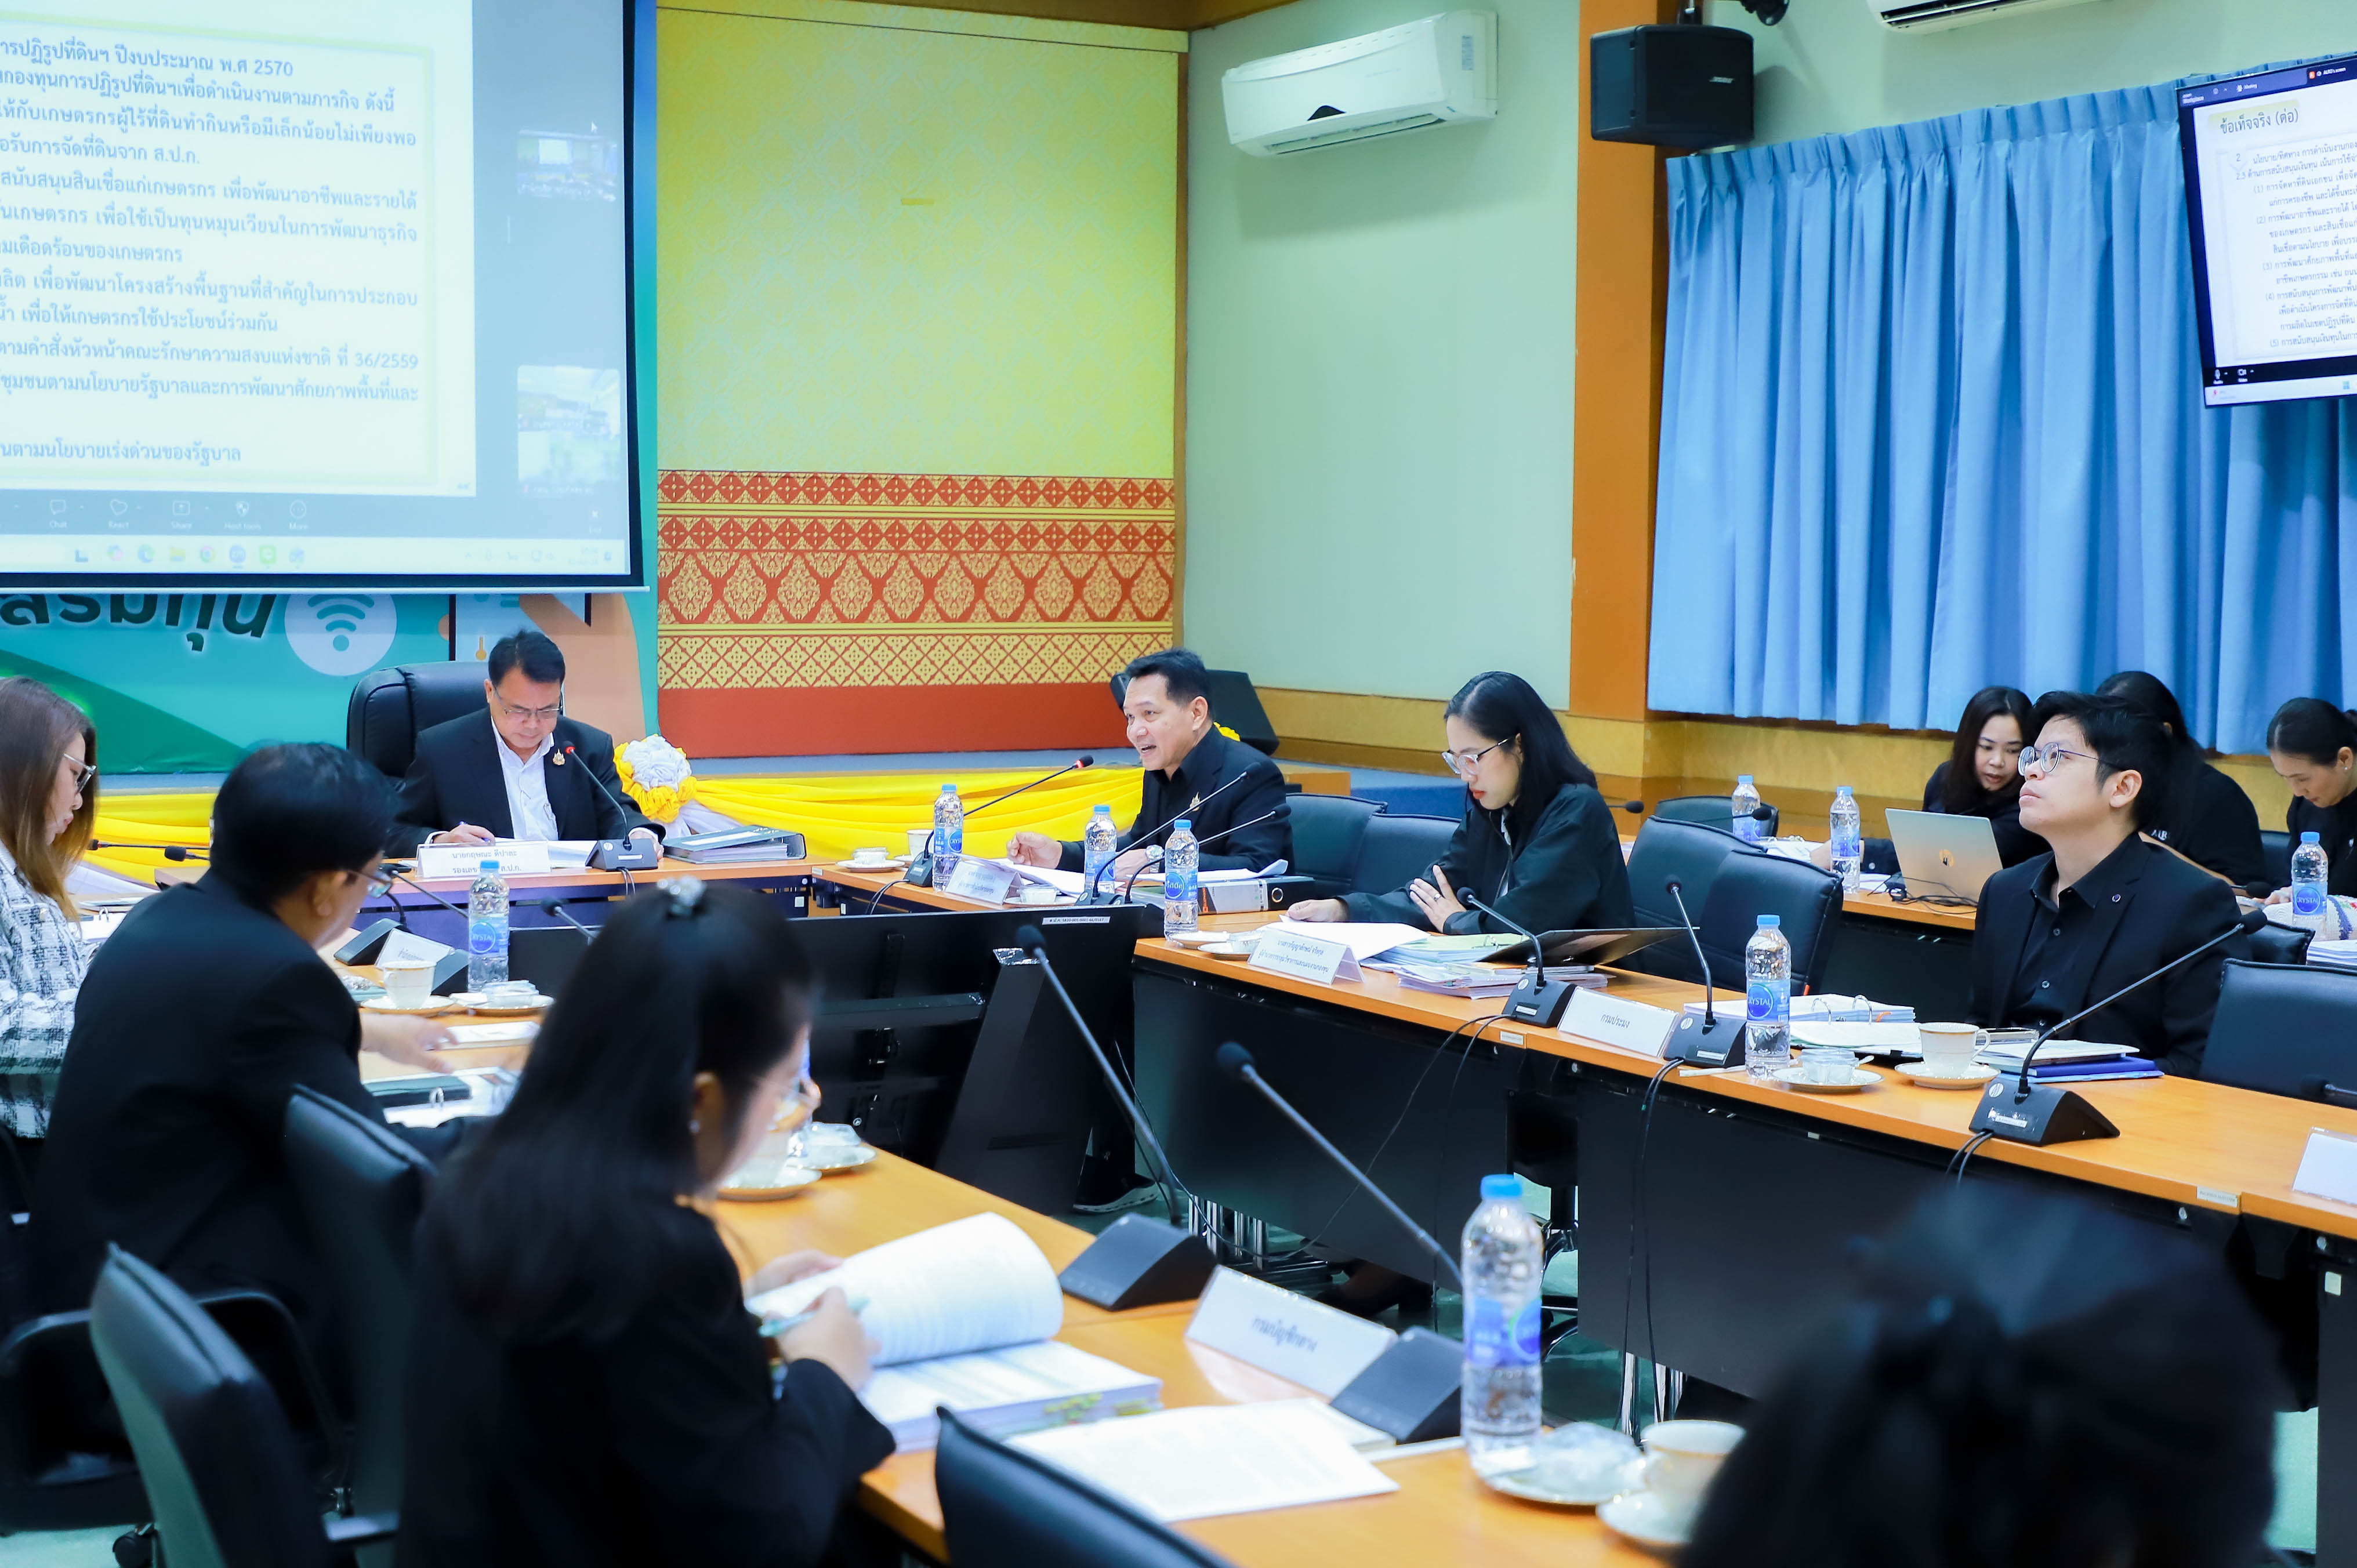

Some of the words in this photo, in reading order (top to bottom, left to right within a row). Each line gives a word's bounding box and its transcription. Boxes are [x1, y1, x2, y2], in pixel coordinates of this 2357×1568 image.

[115, 44, 213, 71] ปีงบประมาณ
[254, 59, 293, 76] 2570
[366, 86, 395, 112] ดังนี้
[2220, 111, 2271, 134] ข้อเท็จจริง
[2275, 108, 2298, 126] (ต่อ)
[154, 146, 200, 164] ส.ป.ก.
[223, 176, 418, 210] เพื่อพัฒนาอาชีพและรายได้
[0, 203, 88, 224] นเกษตรกร
[0, 234, 183, 262] มเดือดร้อนของเกษตรกร
[355, 351, 418, 369] 36/2559
[49, 521, 67, 529] Chat
[1748, 997, 1771, 1008] RYSTAL
[1600, 1014, 1630, 1028] กรมประมง
